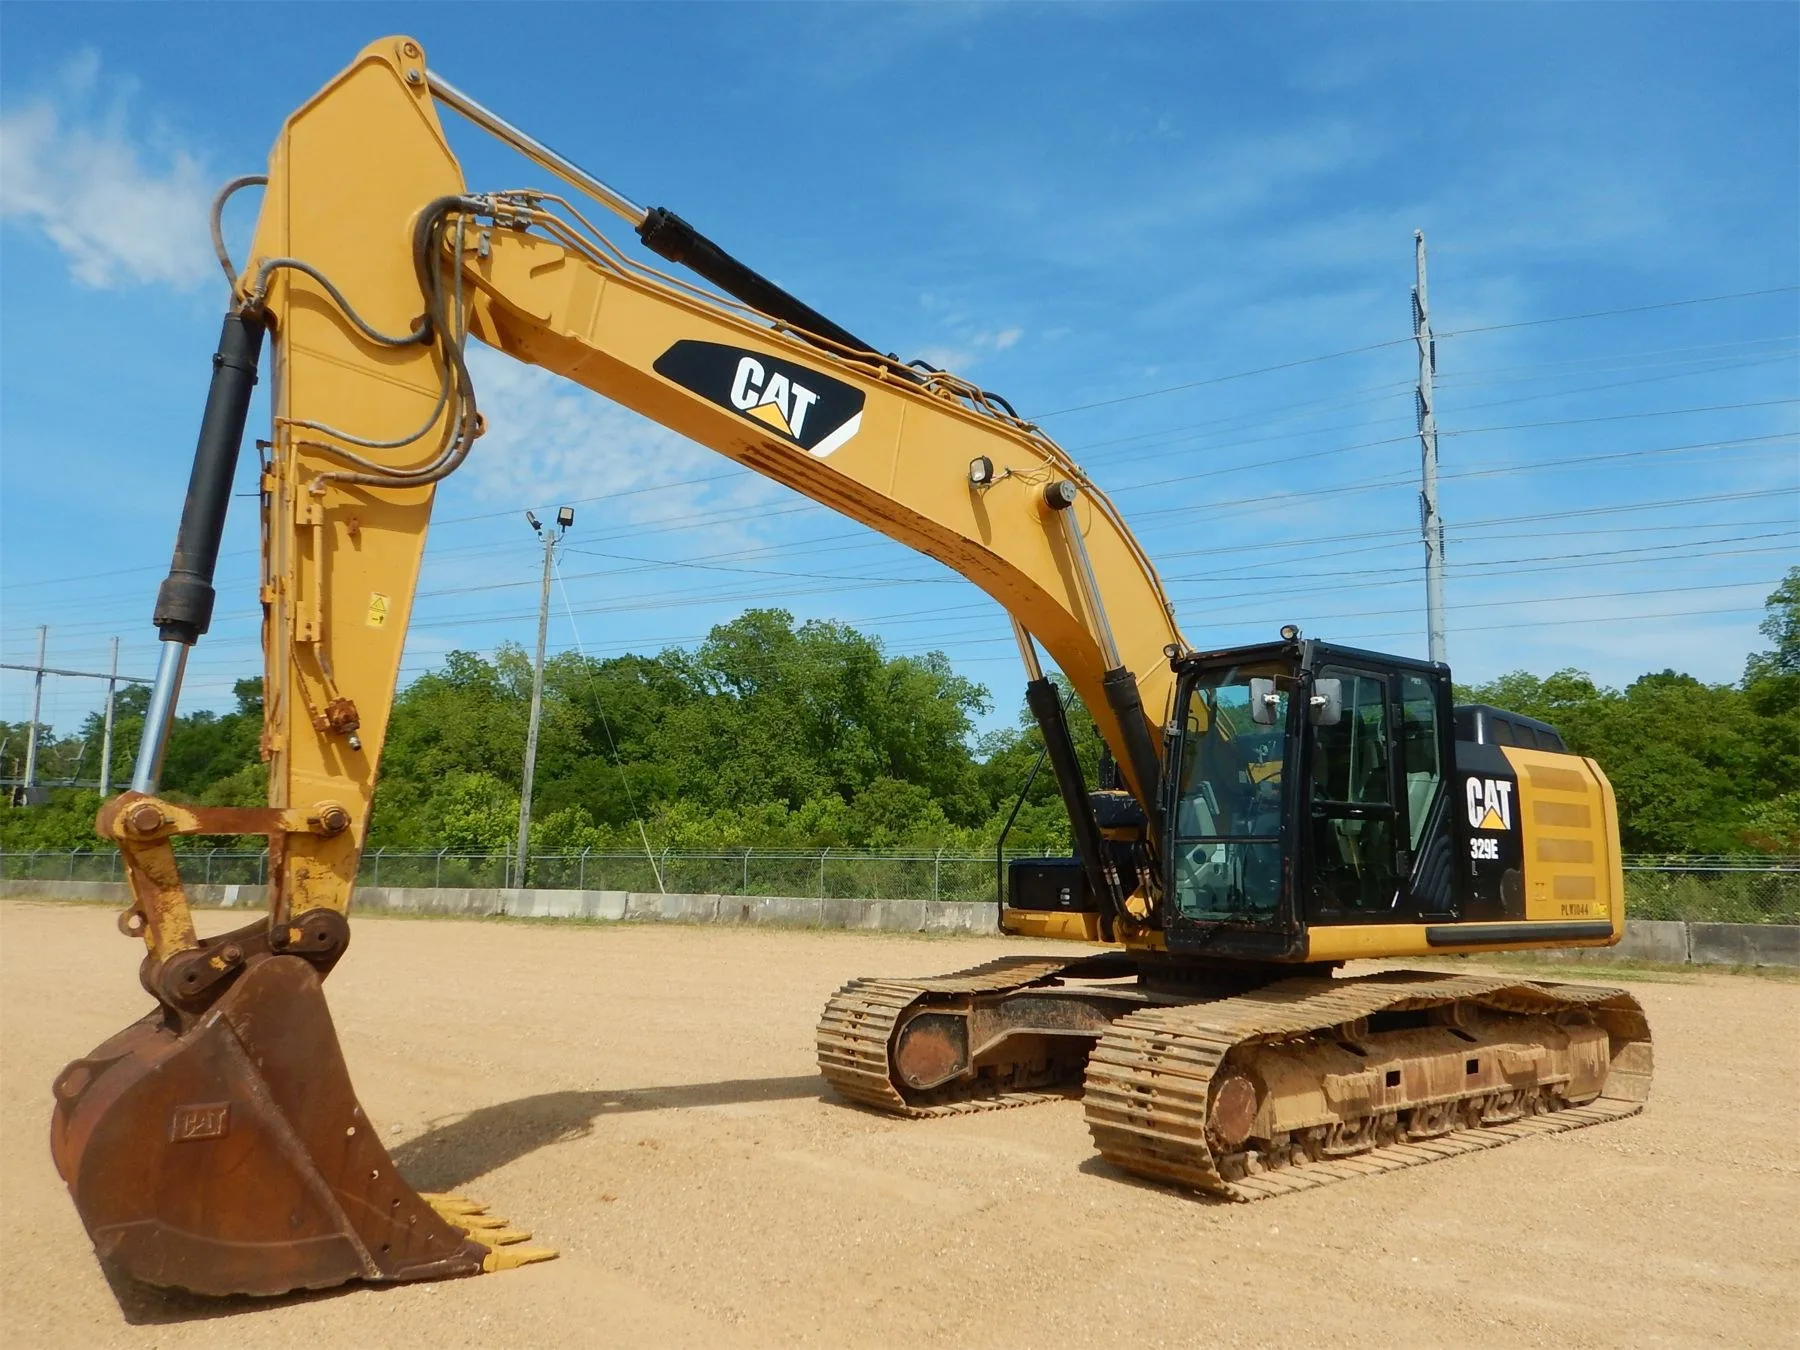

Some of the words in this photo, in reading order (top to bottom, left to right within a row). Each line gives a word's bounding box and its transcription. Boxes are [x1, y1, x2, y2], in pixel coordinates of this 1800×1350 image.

[730, 356, 817, 440] CAT
[1466, 776, 1512, 830] CAT
[1470, 838, 1499, 860] 329E
